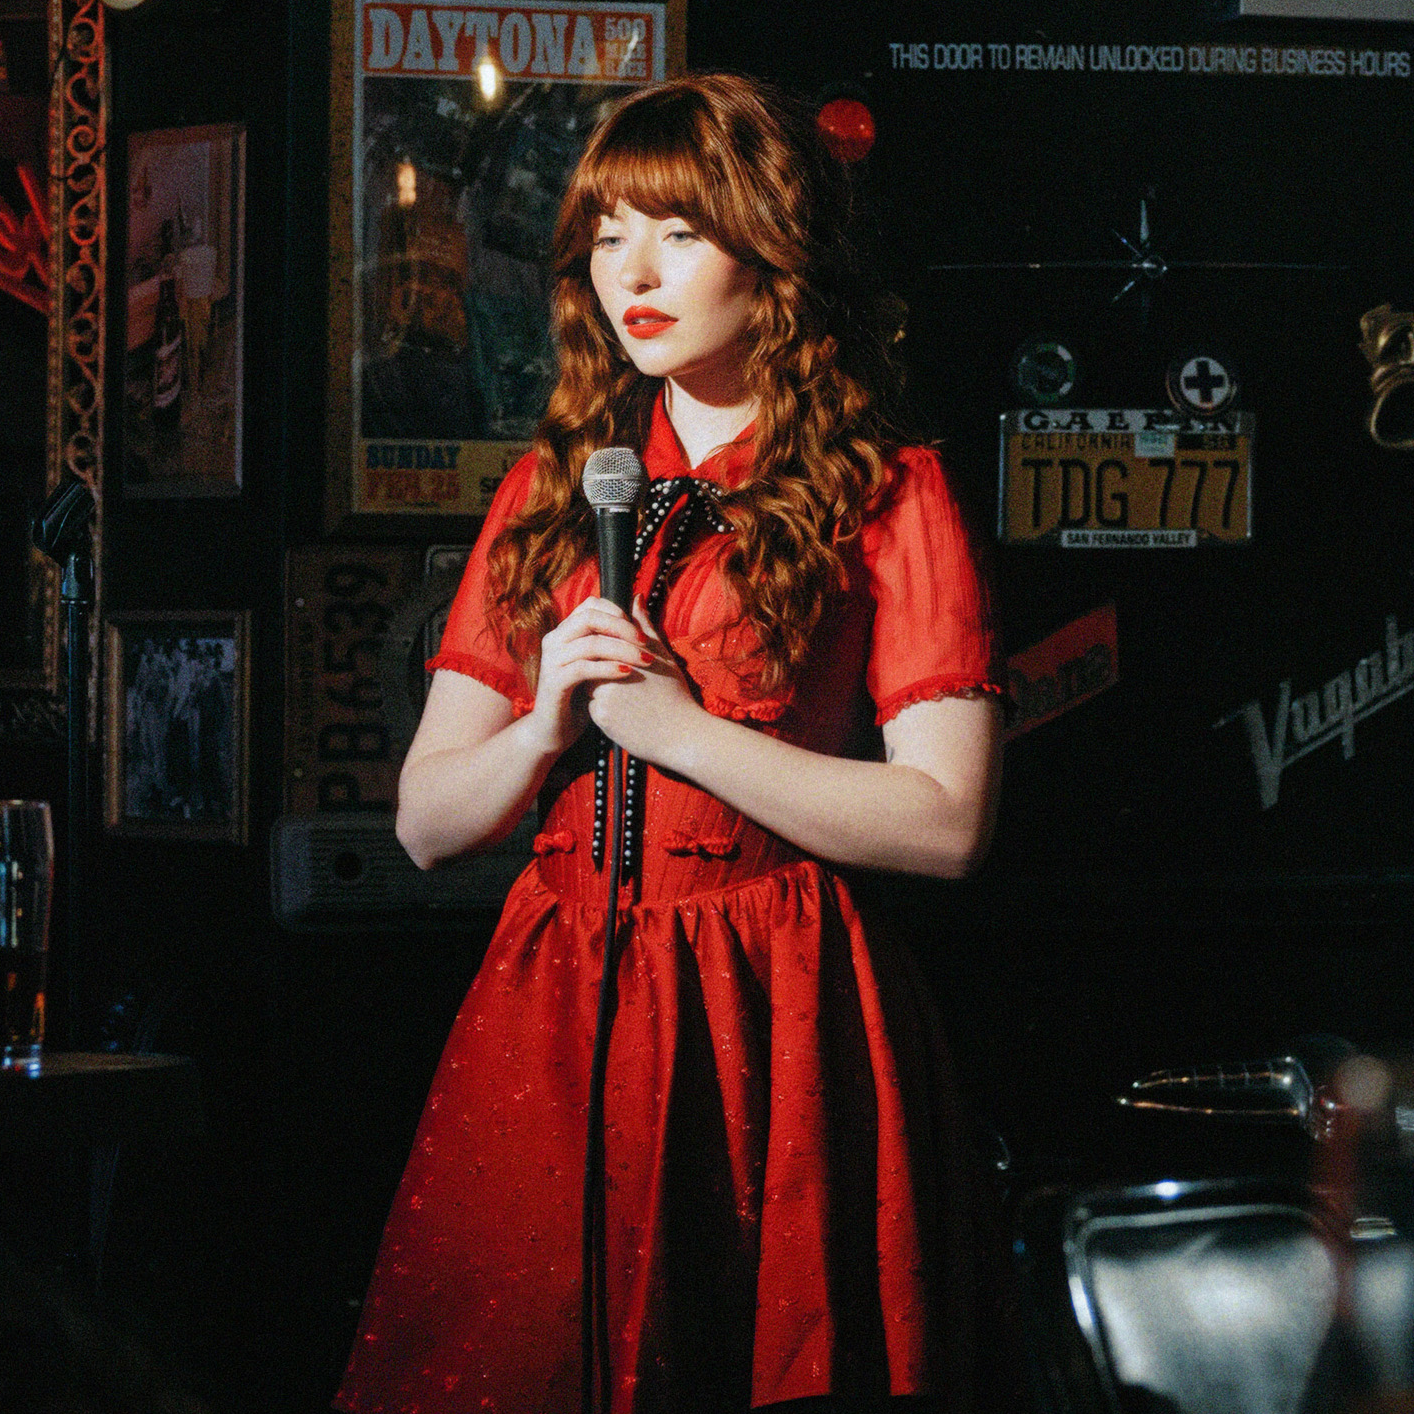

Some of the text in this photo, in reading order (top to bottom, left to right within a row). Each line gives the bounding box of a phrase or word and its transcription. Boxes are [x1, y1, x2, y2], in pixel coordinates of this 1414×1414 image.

[368, 8, 602, 75] DAYTONA
[604, 17, 647, 42] 500
[889, 43, 1412, 78] THIS DOOR TO REMAIN UNLOCKED DURING BUSINESS HOURS
[1021, 435, 1133, 451] CALIFORNIA
[366, 444, 461, 469] SUNDAY
[1021, 457, 1240, 529] TDG 777
[1066, 531, 1193, 546] SAN FERNANDO VALLEY
